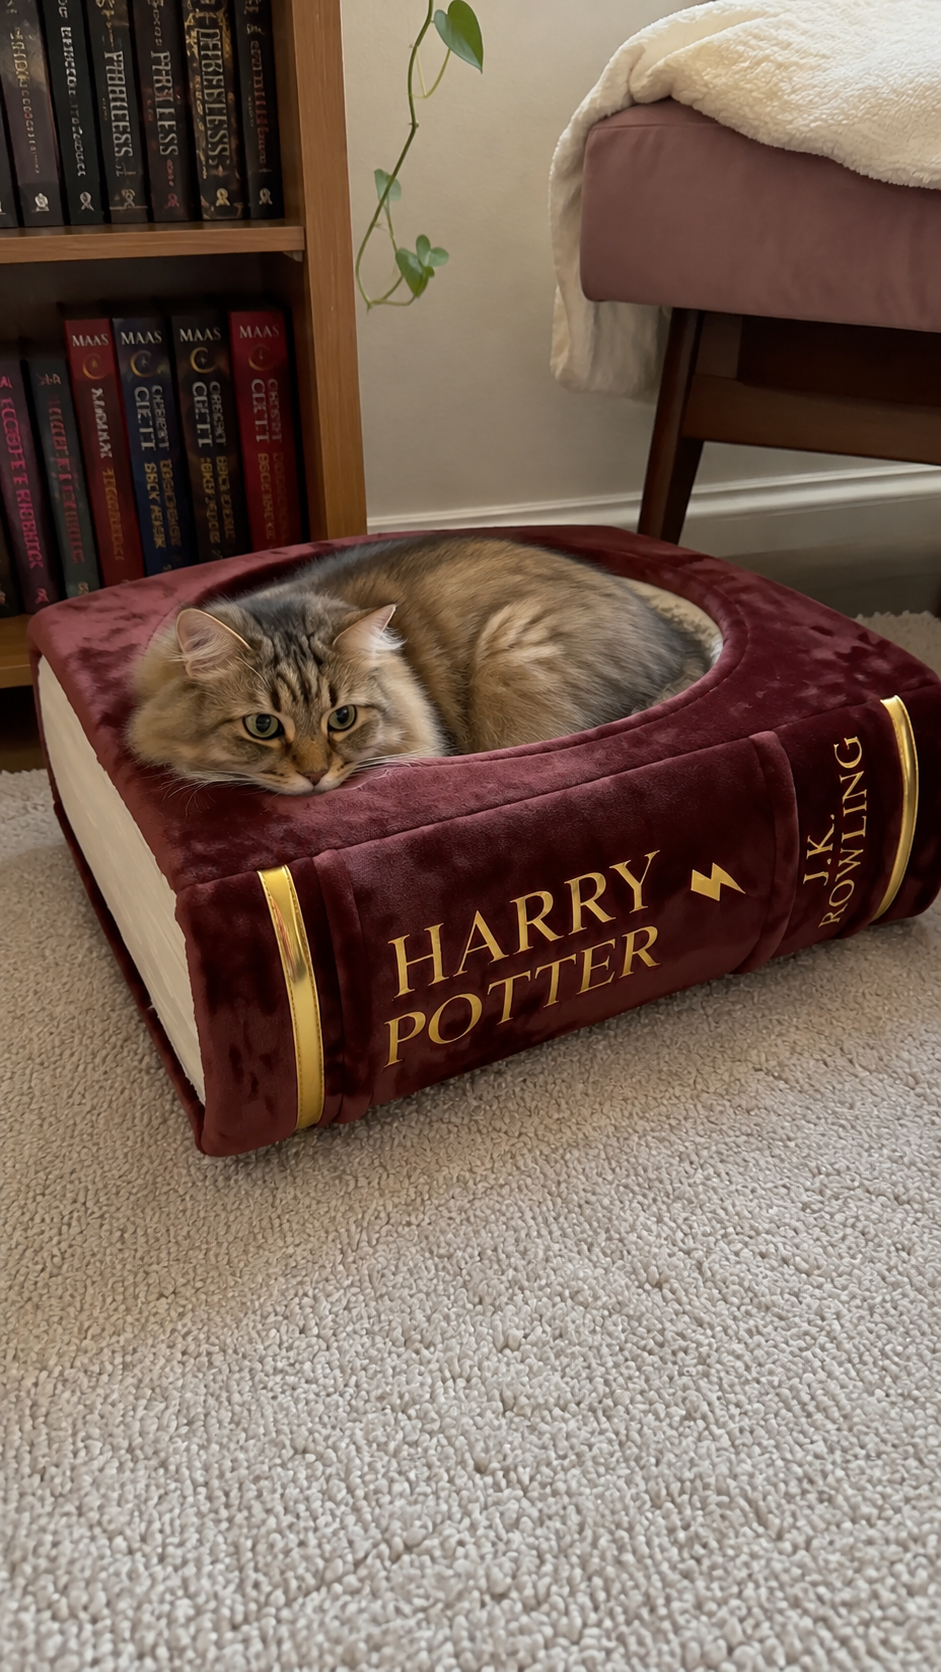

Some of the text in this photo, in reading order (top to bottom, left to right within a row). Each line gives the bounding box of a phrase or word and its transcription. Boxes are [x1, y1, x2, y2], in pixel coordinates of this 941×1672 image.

[72, 333, 110, 348] MAAS
[120, 330, 163, 346] MAAS
[179, 328, 222, 343] MAAS
[239, 325, 280, 340] MAAS
[803, 814, 835, 886] J.K.
[818, 736, 867, 928] ROWLING
[388, 849, 661, 999] HARRY
[383, 925, 661, 1068] POTTER
